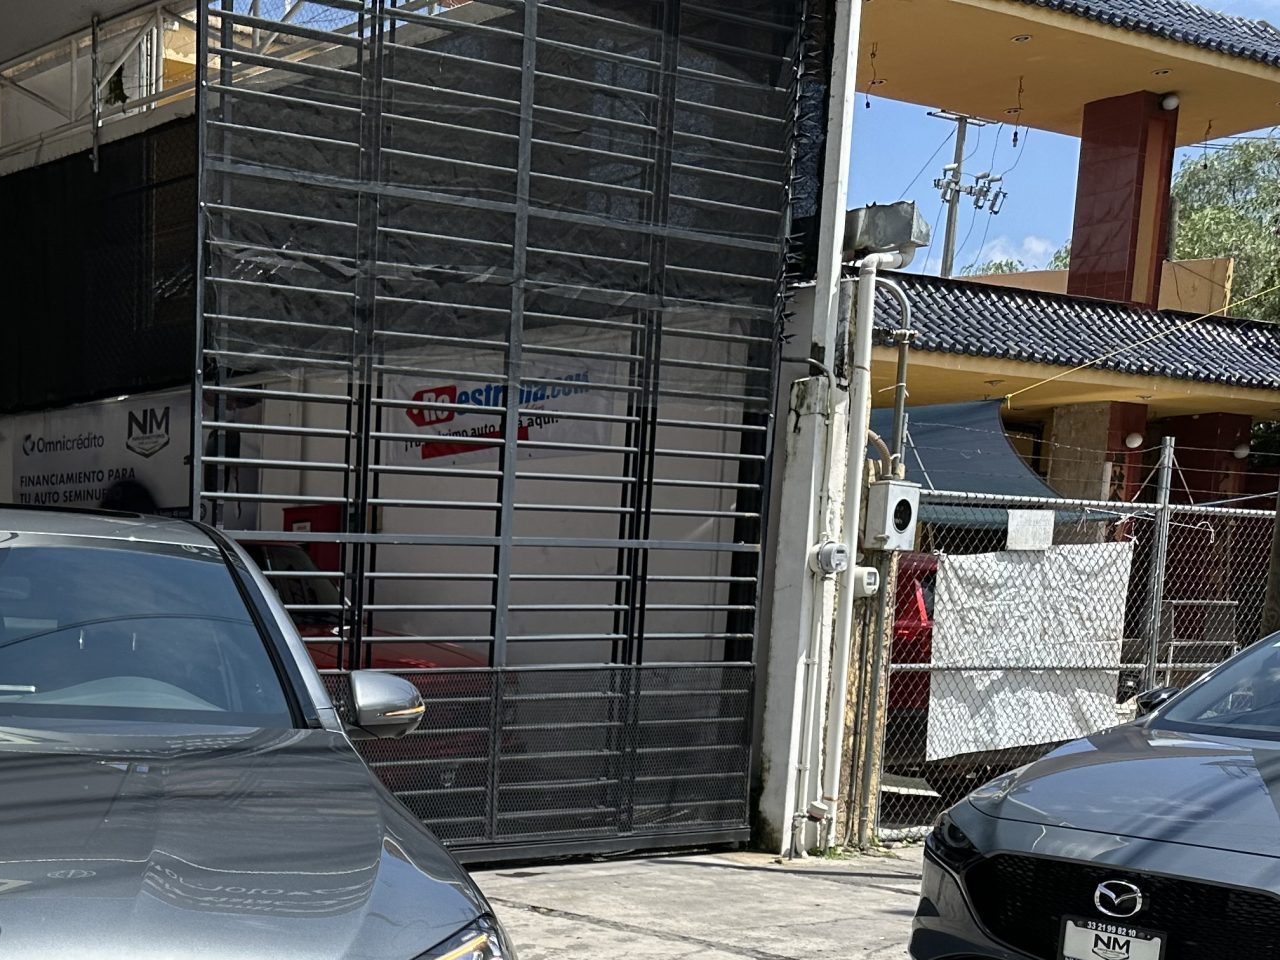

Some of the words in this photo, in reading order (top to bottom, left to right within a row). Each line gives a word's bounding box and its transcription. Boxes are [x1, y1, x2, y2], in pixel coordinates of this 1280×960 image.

[128, 406, 170, 440] NM
[470, 423, 495, 438] auto
[36, 432, 105, 453] Omnicrédito
[20, 469, 105, 488] FINANCIAMIENTO
[108, 467, 136, 482] PARA
[20, 493, 31, 504] TU
[34, 492, 60, 504] AUTO
[1087, 920, 1096, 930] 33
[1097, 923, 1106, 931] 21
[1106, 924, 1116, 933] 99
[1128, 928, 1136, 937] 10
[1093, 933, 1131, 955] NM
